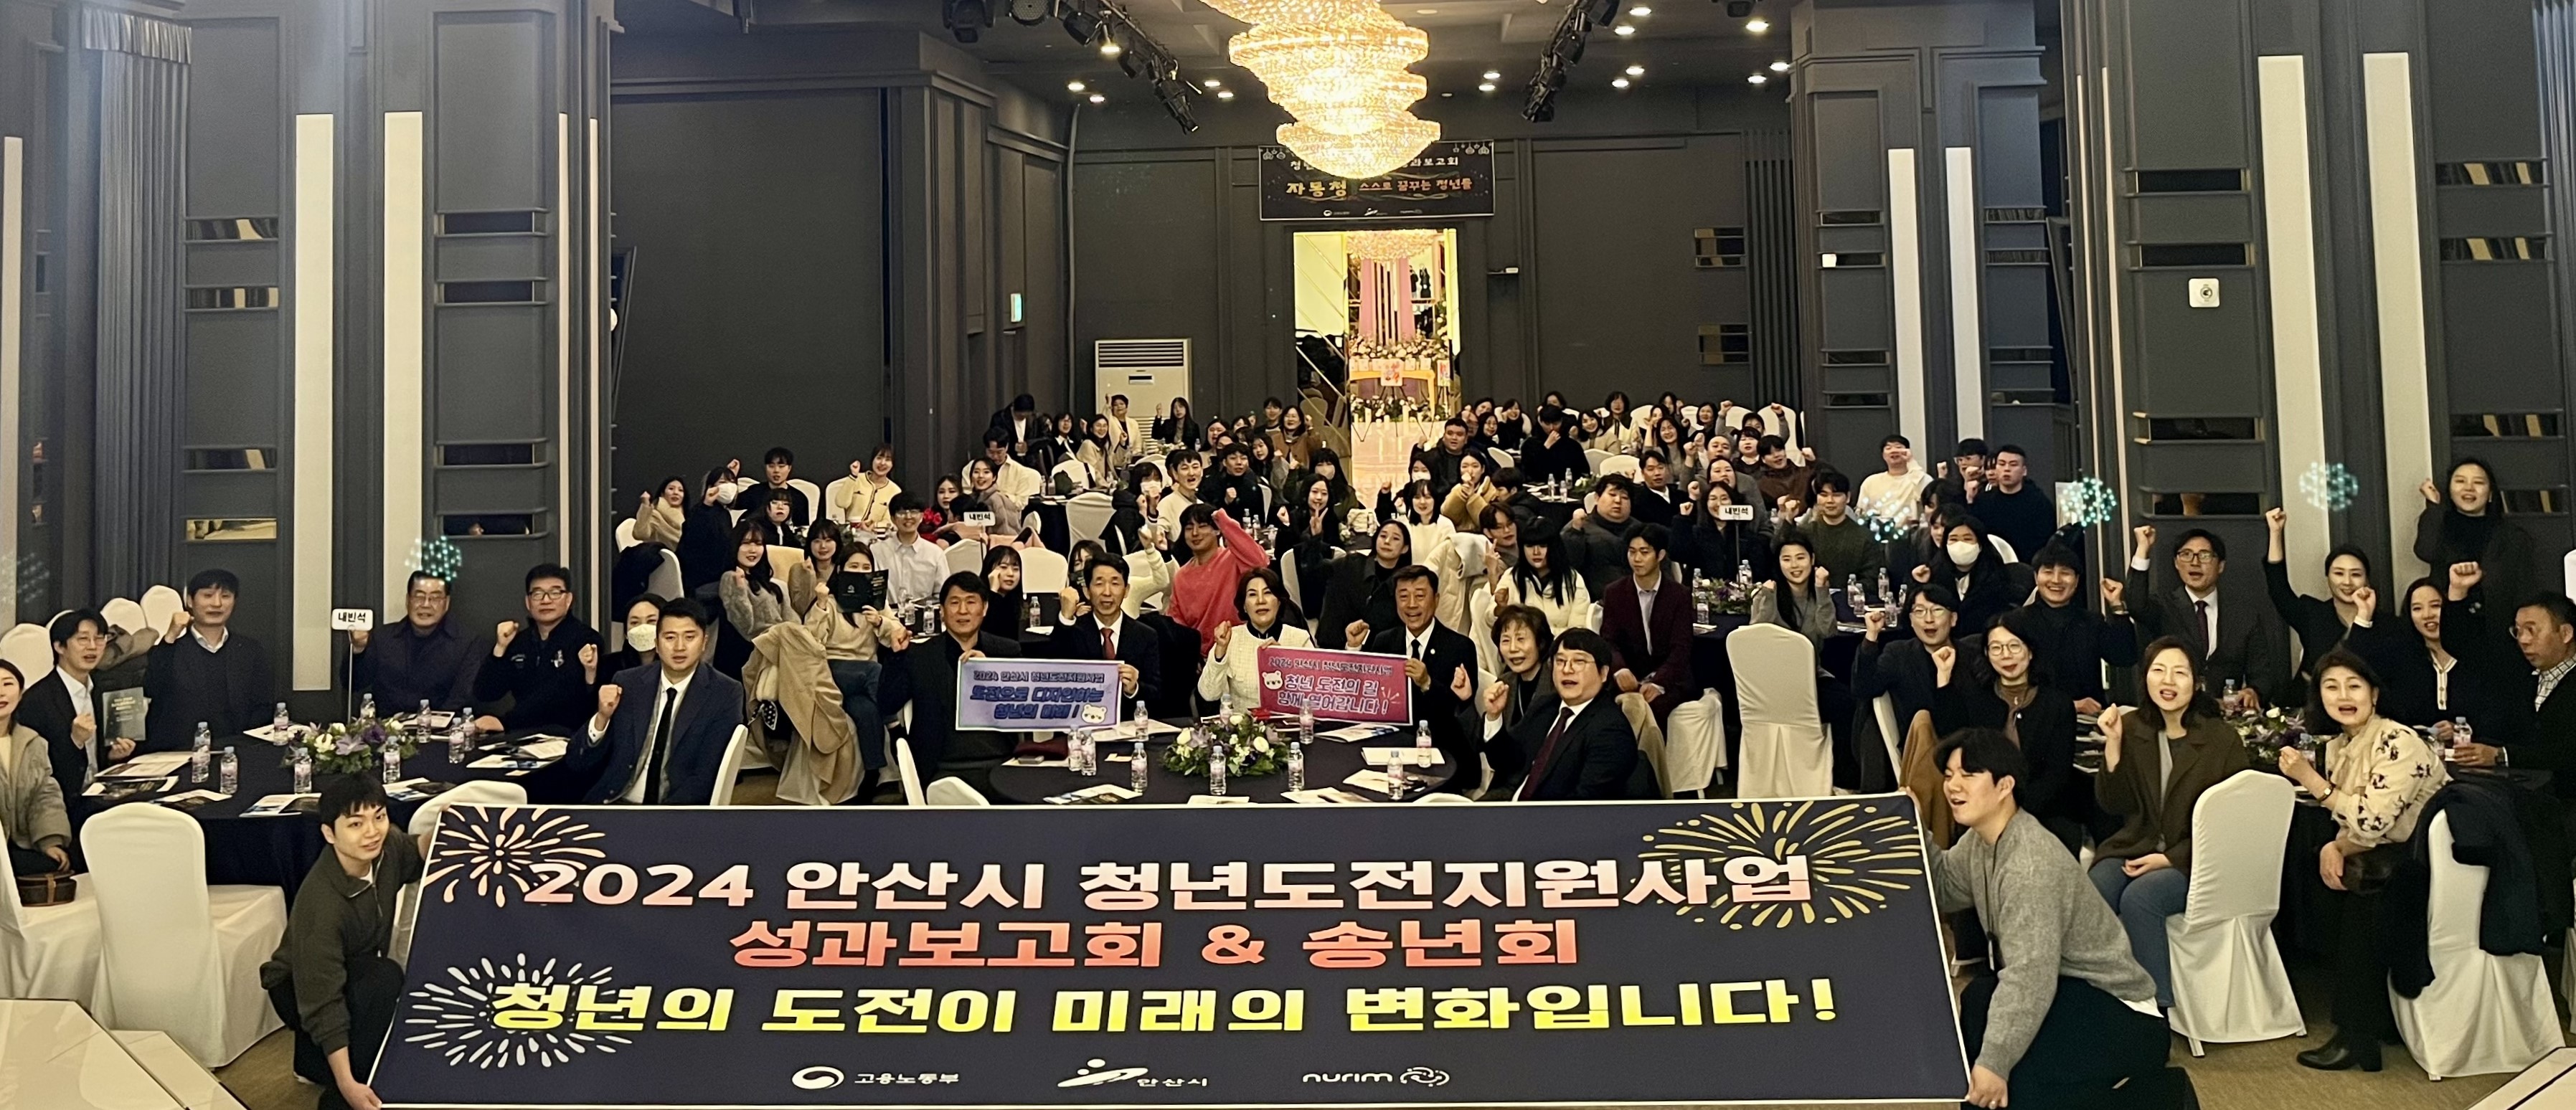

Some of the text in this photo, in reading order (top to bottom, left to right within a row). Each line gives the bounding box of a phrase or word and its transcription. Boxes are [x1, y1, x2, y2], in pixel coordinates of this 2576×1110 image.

[1402, 156, 1458, 168] 과보고회
[1359, 181, 1393, 191] 스스로
[338, 612, 366, 623] 내빈석
[1268, 656, 1291, 668] 2024
[973, 670, 999, 681] 2024
[1001, 671, 1029, 682] 안산시
[1285, 674, 1379, 697] 청년 도전의 길
[970, 685, 1029, 702] 도전으로
[524, 855, 1811, 911] 2024 안산시 청년도전지원사업
[730, 919, 1577, 968] 성과보고회 & 송년회
[492, 978, 1838, 1033] 청년의 도전이 미래의 변화입니다!
[854, 1073, 959, 1085] 고용노동부
[1137, 1078, 1208, 1087] 안산시
[1302, 1073, 1393, 1083] nurim
